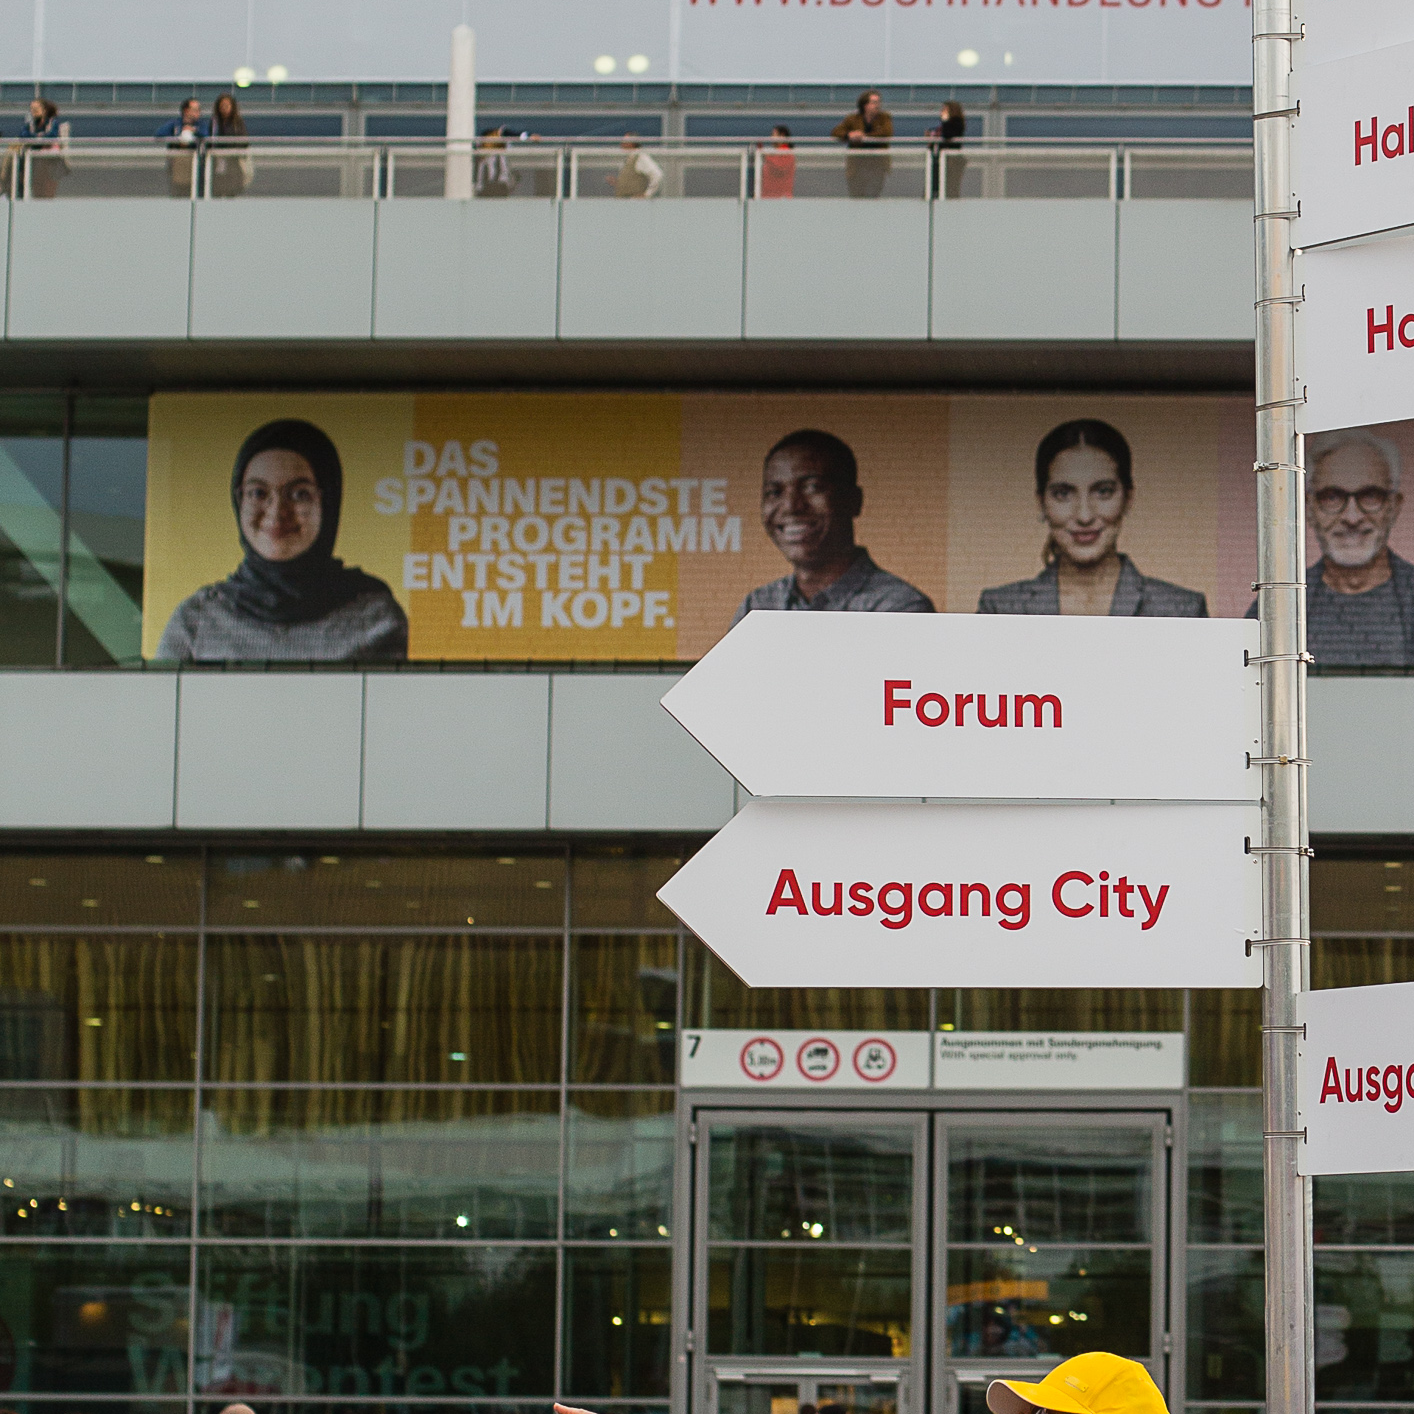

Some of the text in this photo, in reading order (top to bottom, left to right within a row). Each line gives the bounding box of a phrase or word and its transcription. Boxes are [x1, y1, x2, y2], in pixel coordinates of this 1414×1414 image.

[403, 440, 498, 477] DAS
[374, 477, 729, 515] SPANNENDSTE
[448, 517, 742, 552] PROGRAMM
[402, 553, 653, 590] ENTSTEHT
[461, 591, 676, 628] IM KOPF.
[883, 679, 1063, 729] Forum
[765, 868, 1171, 931] Ausgang City
[686, 1035, 702, 1060] 7
